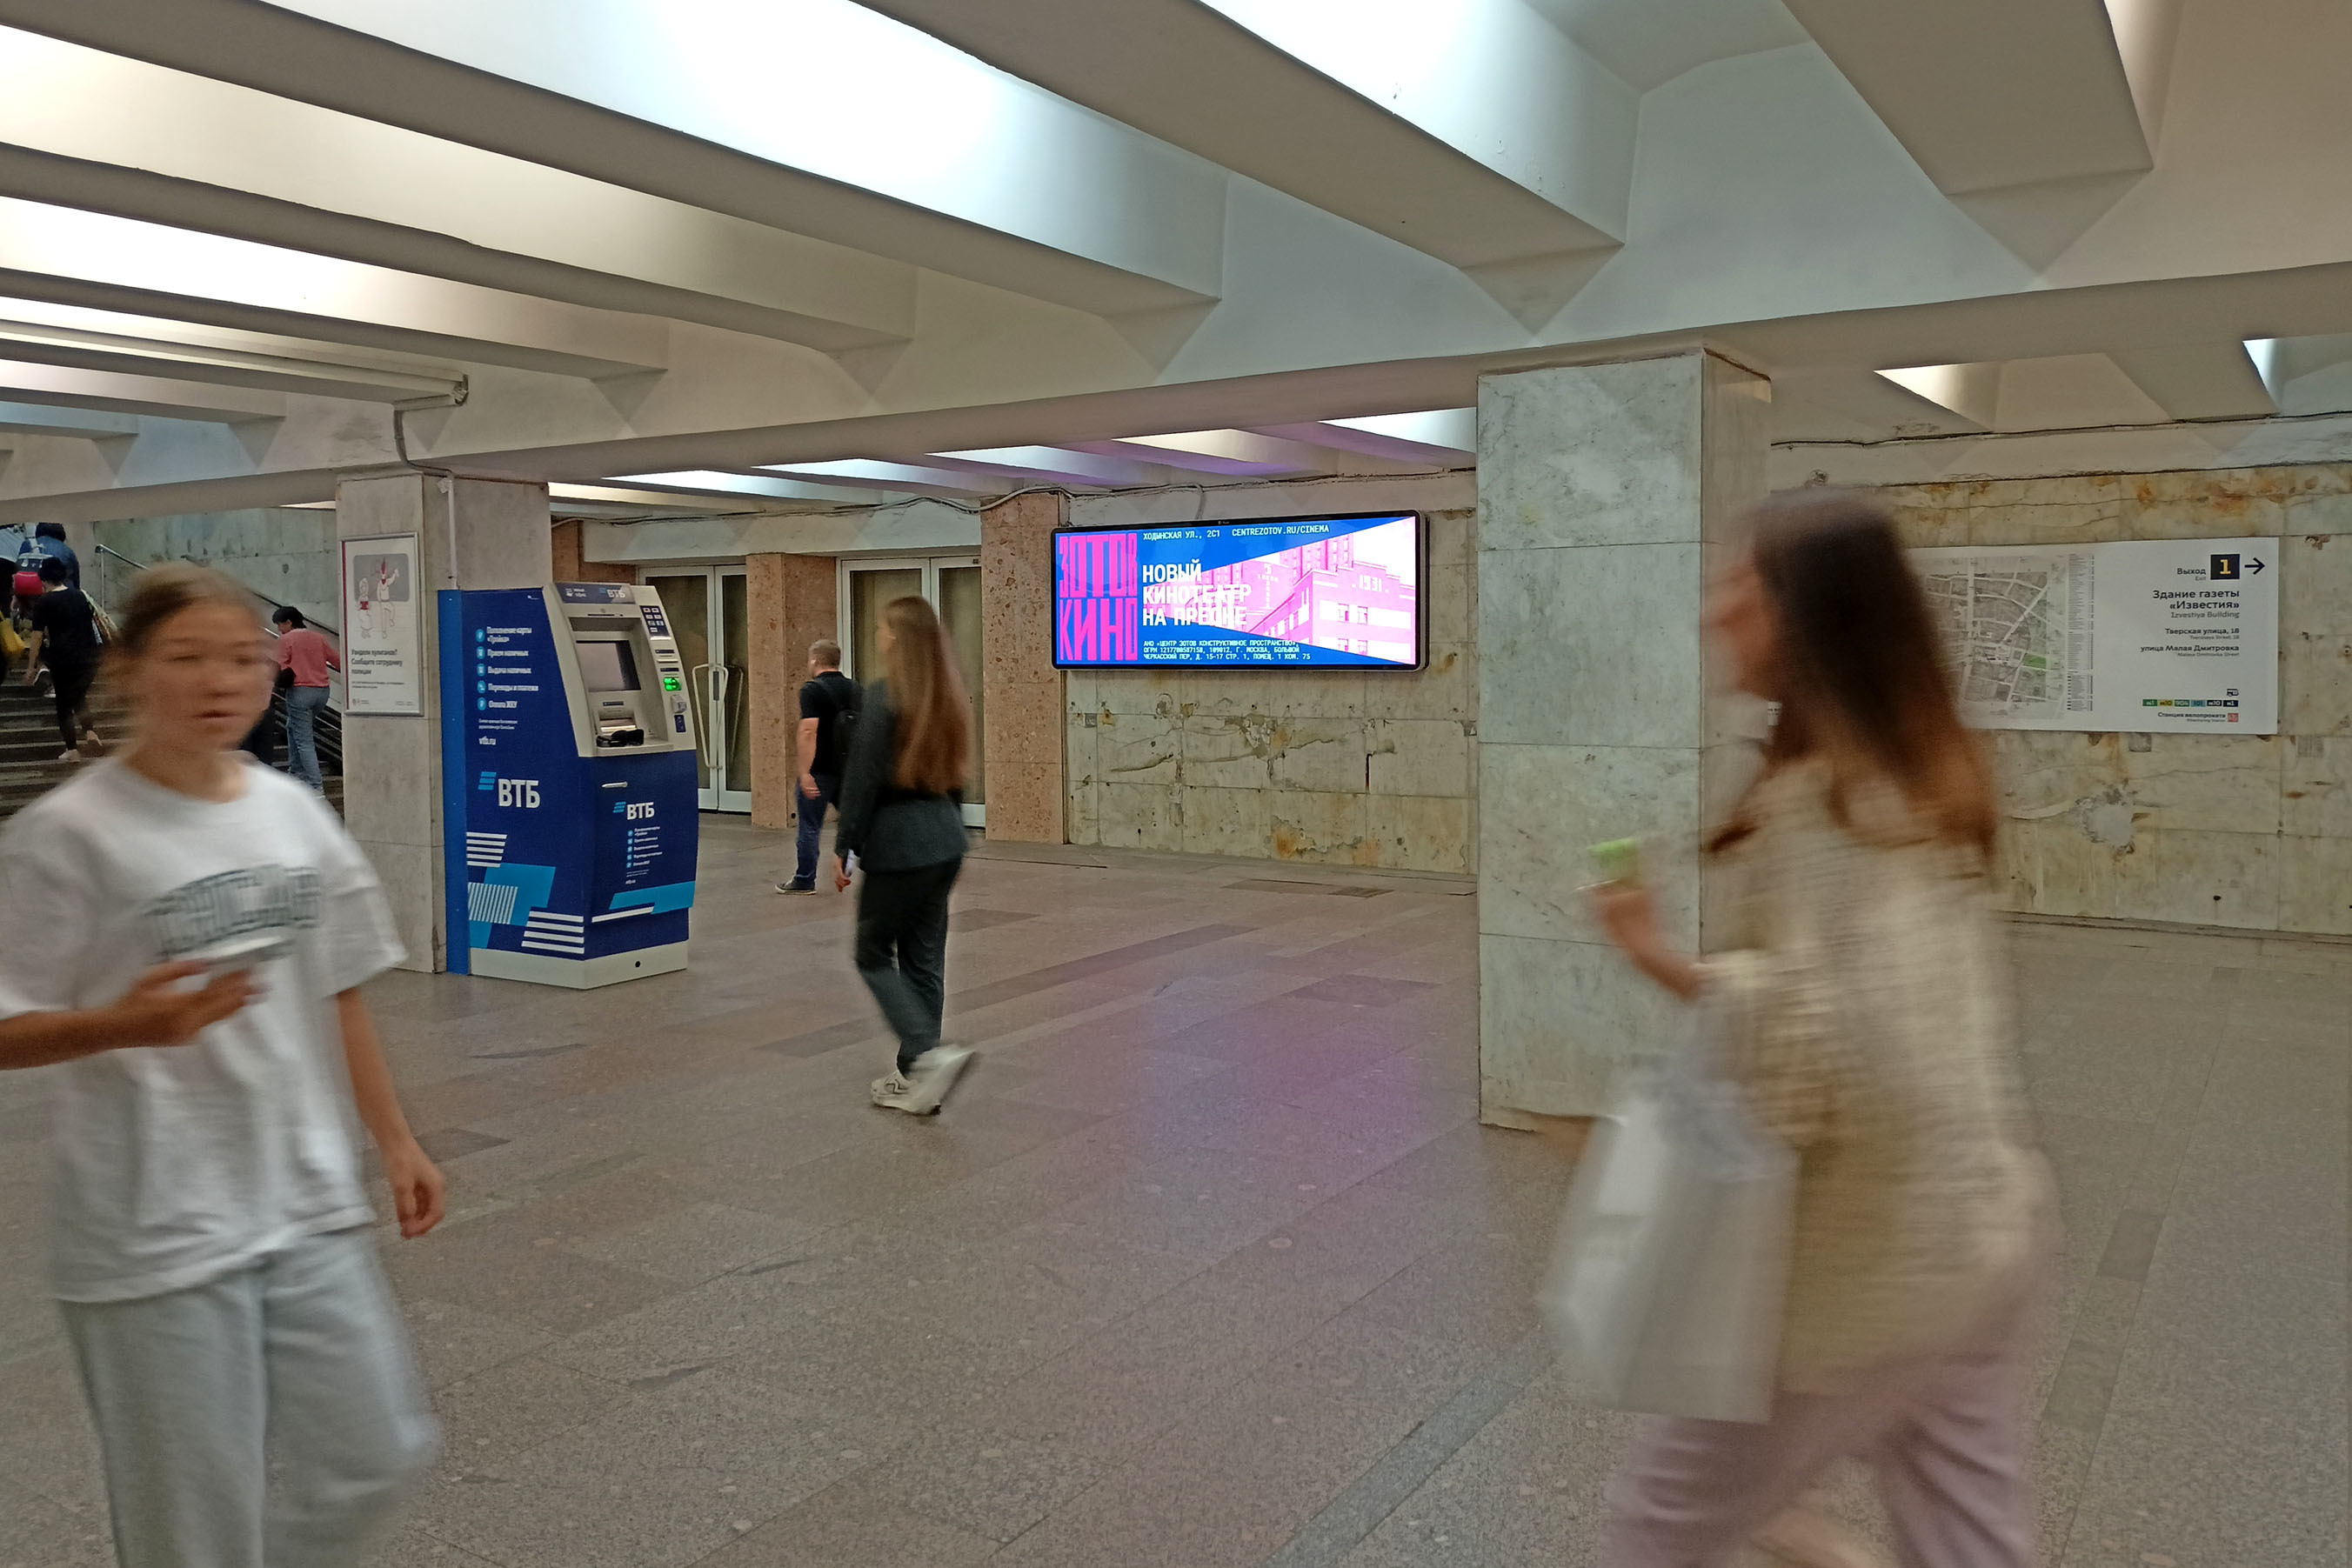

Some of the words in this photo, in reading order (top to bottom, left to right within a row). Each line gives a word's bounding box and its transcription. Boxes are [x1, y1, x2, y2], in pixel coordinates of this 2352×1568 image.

[1143, 530, 1182, 541] ХОДЫНСКАЯ
[1185, 530, 1202, 539] УЛ.,
[1232, 524, 1329, 537] CENTREZOTOV.RU/CINEMA
[1059, 533, 1138, 598] ЗОТОВ
[1142, 558, 1202, 584] НОВЫЙ
[2176, 567, 2207, 576] Выход
[2219, 558, 2232, 575] 1
[607, 589, 625, 598] ВТБ
[1142, 584, 1253, 604] КИНОТЕАТР
[2152, 590, 2196, 600] Здание
[2199, 590, 2240, 598] газеты
[2169, 600, 2240, 610] «Известия»
[1142, 608, 1167, 626] НА
[1059, 597, 1138, 661] КИНО
[498, 778, 541, 809] ВТБ
[626, 802, 655, 820] ВТБ
